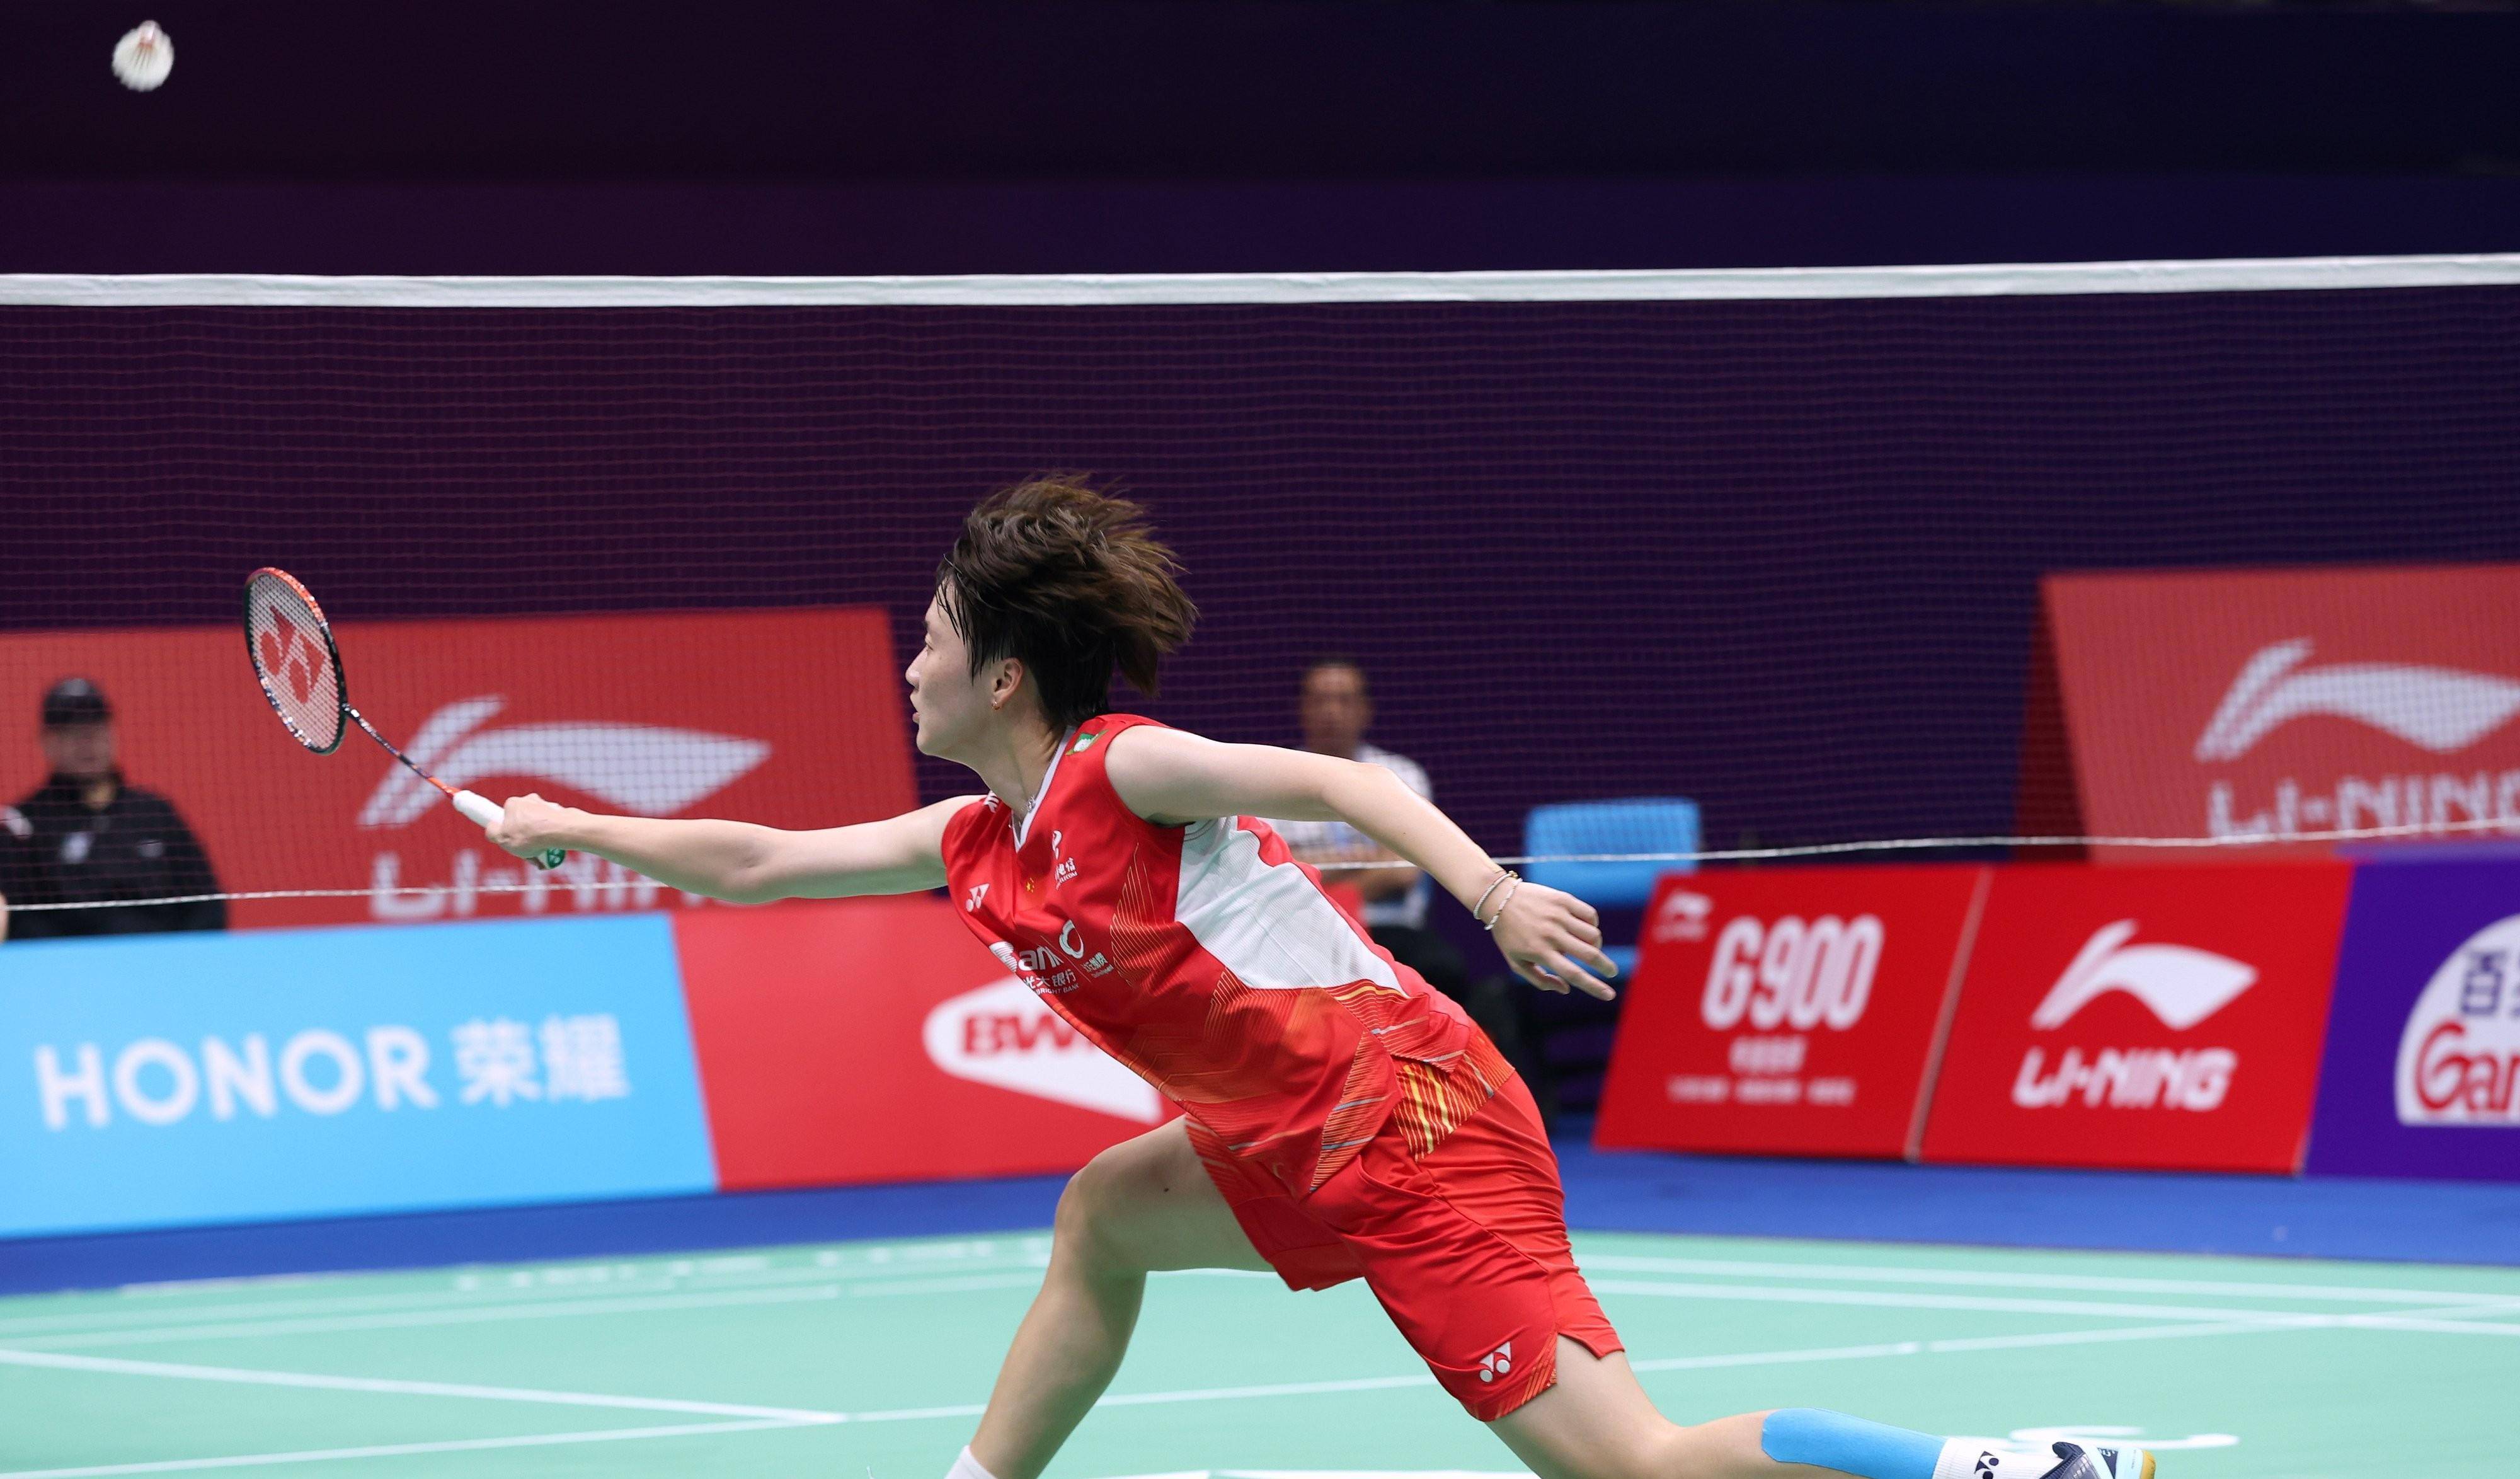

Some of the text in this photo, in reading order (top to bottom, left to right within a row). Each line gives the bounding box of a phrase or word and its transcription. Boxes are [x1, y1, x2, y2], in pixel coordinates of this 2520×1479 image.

[1024, 969, 1076, 989] 光大银行
[1035, 986, 1062, 995] BRIGHT
[2460, 950, 2520, 1017] 百
[962, 1011, 1096, 1054] BW
[34, 1014, 630, 1131] HONOR 荣耀
[2013, 1046, 2238, 1111] LI-NING
